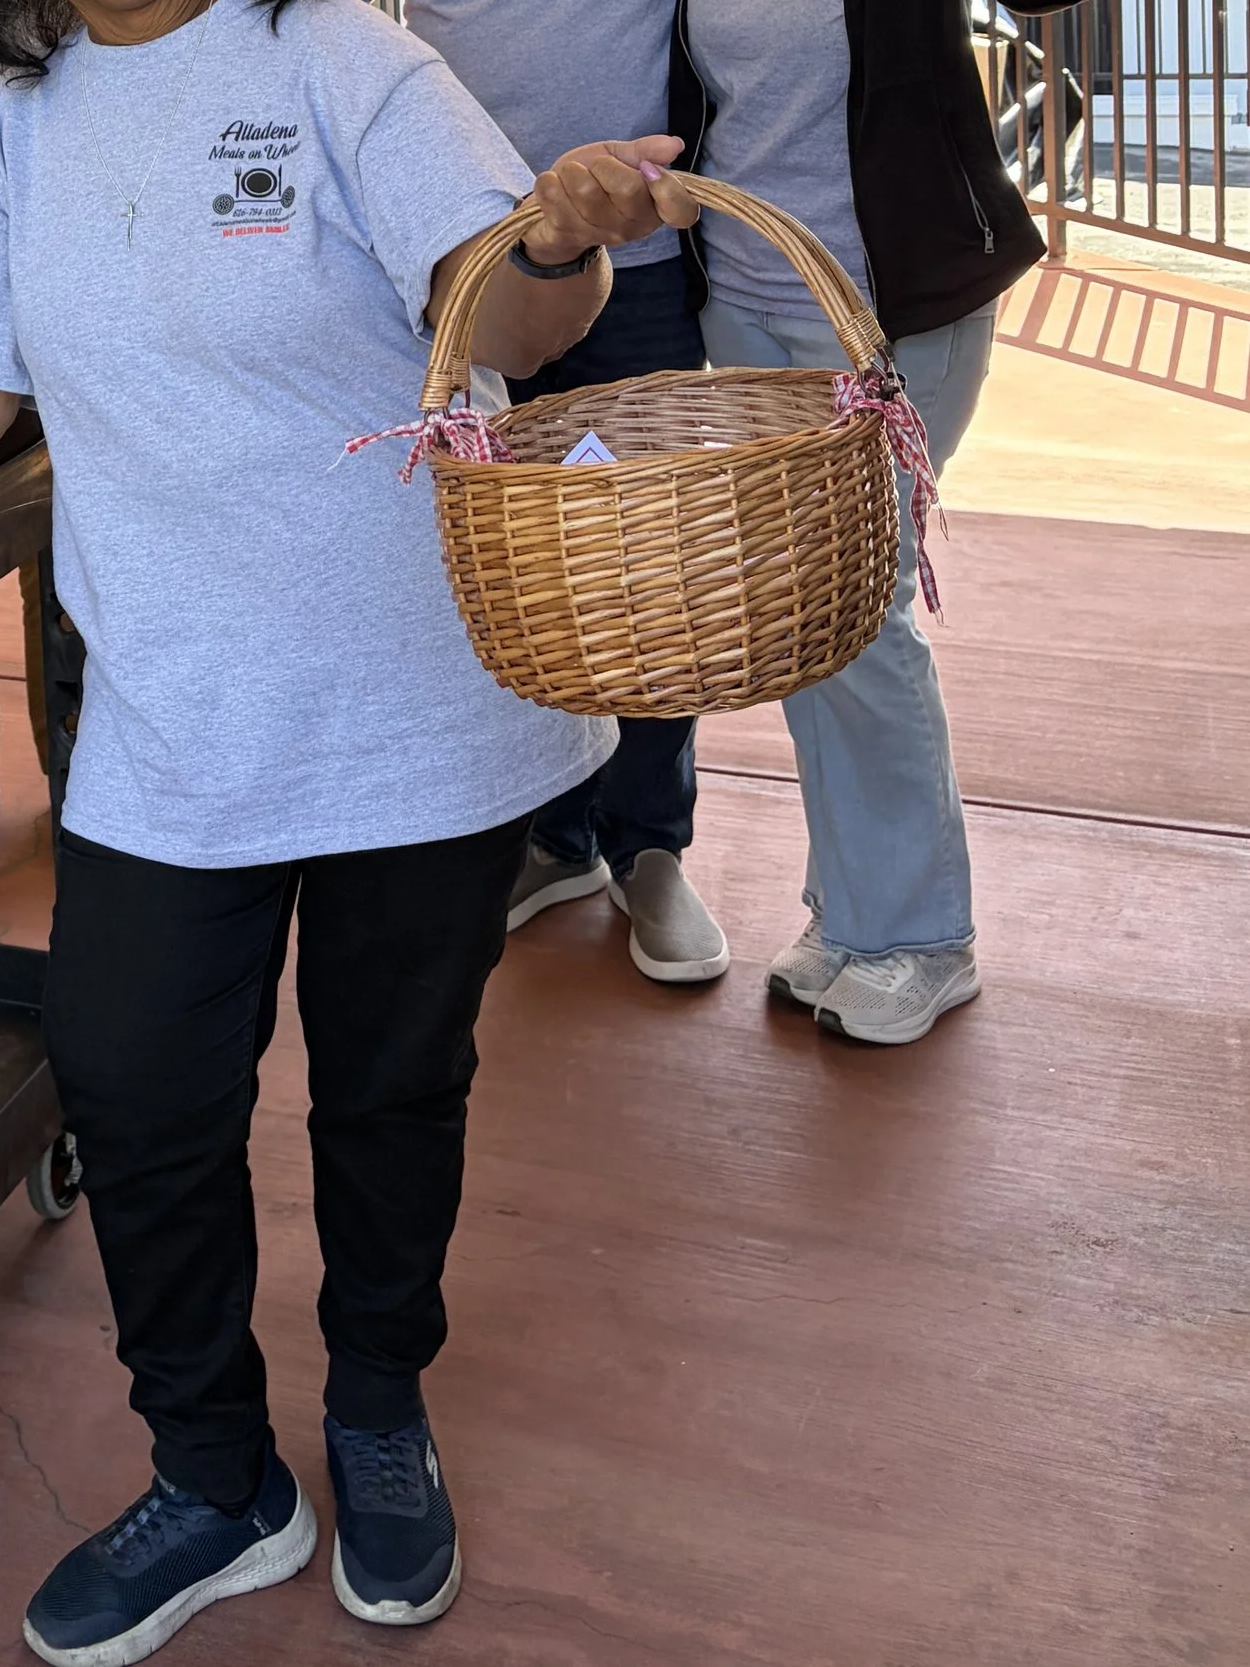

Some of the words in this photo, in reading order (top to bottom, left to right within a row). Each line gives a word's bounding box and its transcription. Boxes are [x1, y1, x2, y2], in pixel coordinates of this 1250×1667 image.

[219, 119, 299, 142] Altadena
[208, 145, 245, 160] Meals
[248, 149, 262, 159] on
